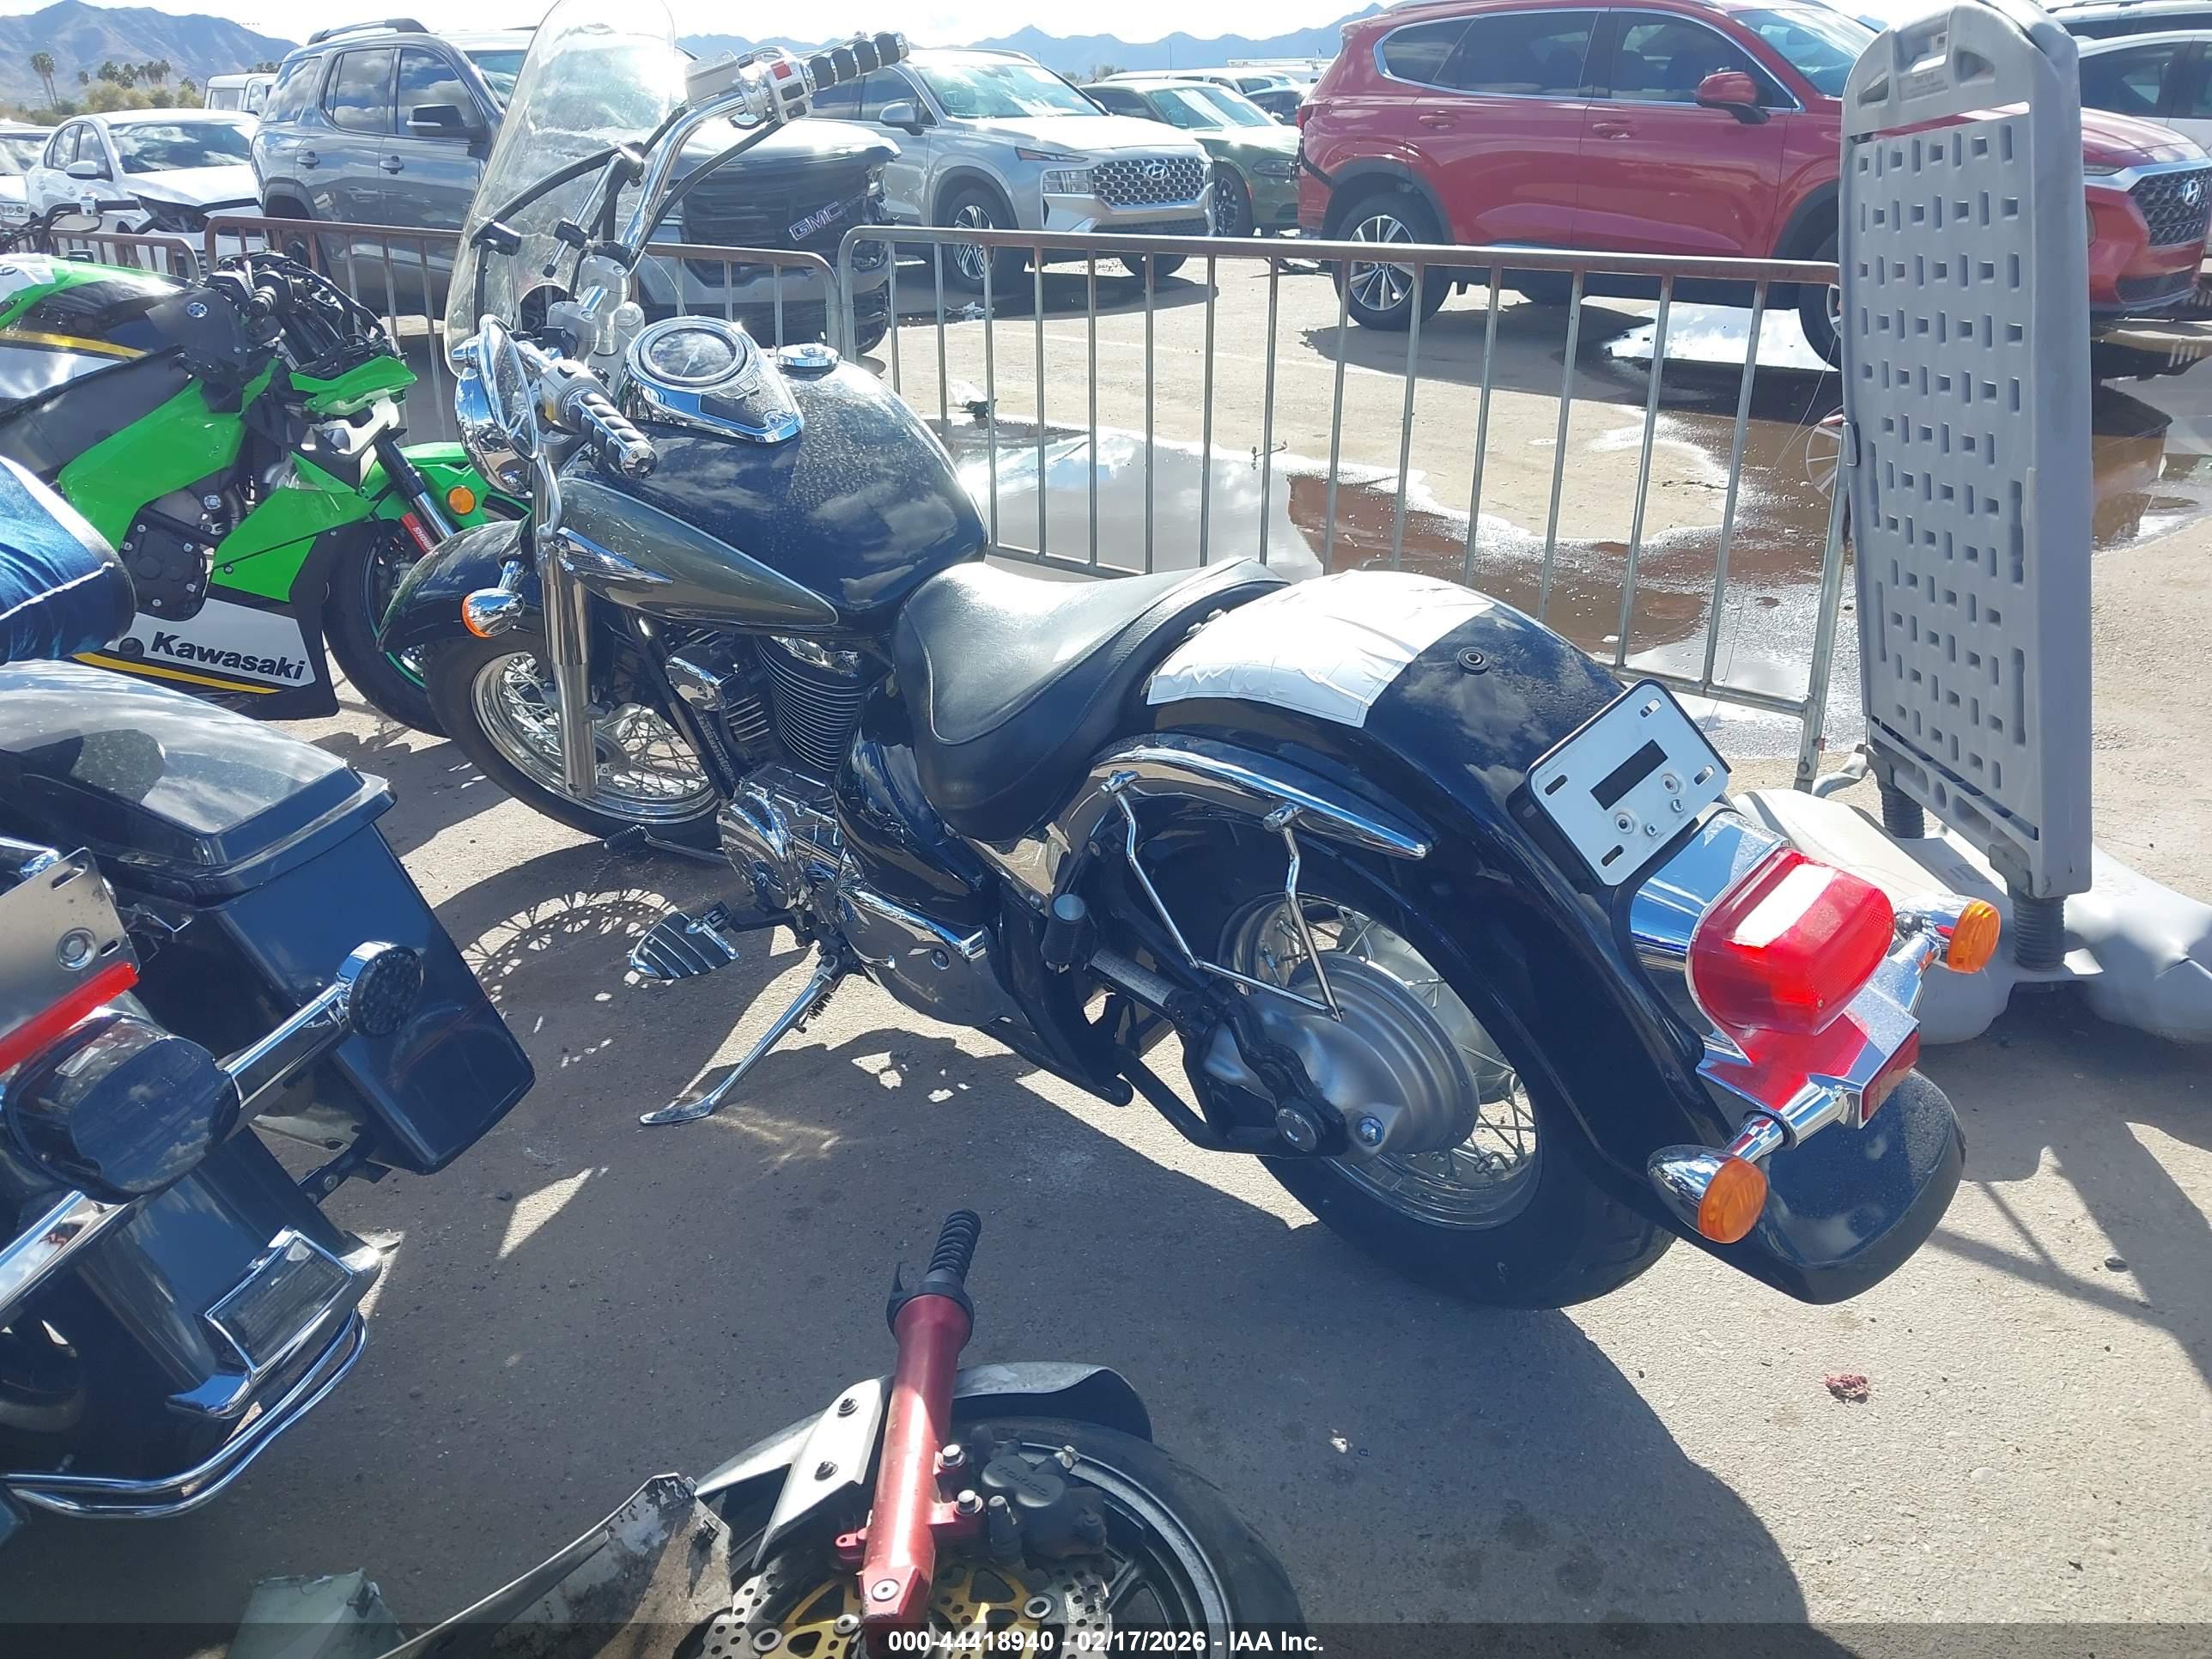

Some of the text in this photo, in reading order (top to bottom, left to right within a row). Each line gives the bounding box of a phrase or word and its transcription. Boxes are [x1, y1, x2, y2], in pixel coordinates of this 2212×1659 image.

[789, 201, 843, 241] GMC
[150, 630, 306, 680] Kawasaki
[997, 1464, 1049, 1497] TOKICO
